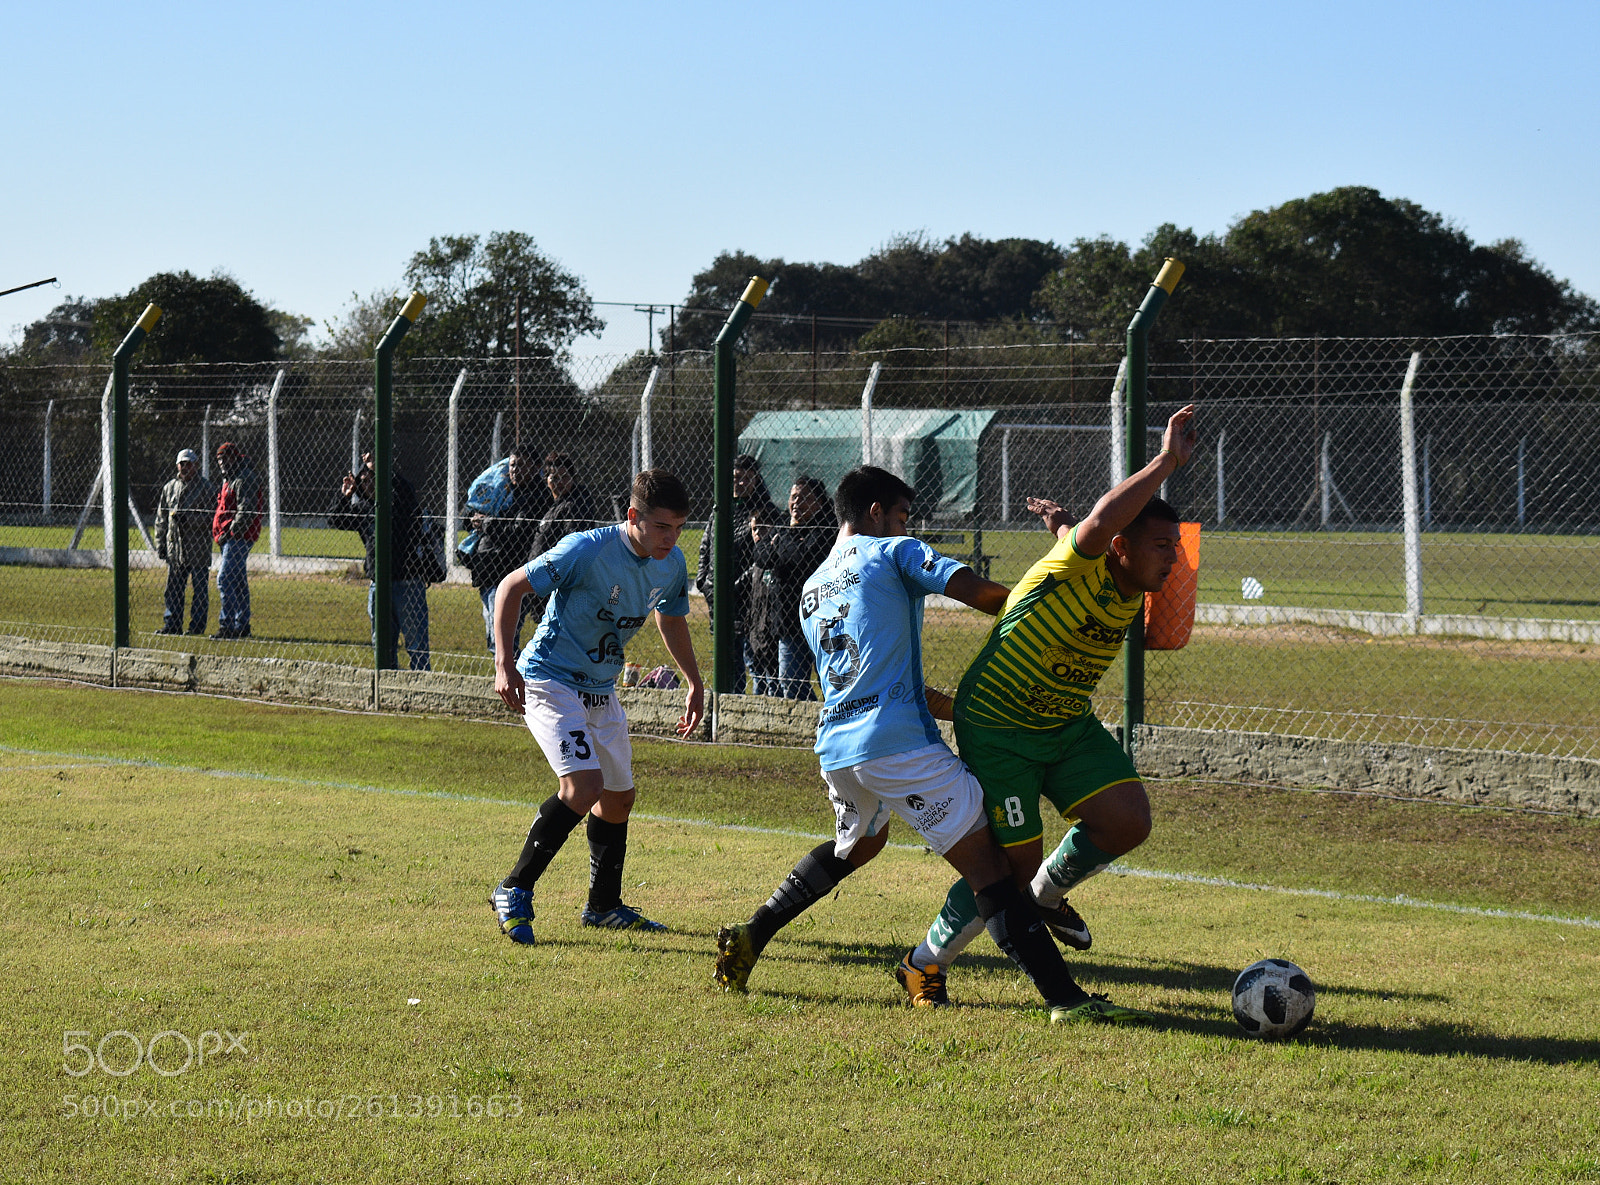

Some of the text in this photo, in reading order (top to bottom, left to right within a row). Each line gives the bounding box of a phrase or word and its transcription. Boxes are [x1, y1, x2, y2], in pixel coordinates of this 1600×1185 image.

[820, 573, 861, 602] MEDICINE
[568, 730, 591, 760] 3
[1004, 796, 1025, 828] 8
